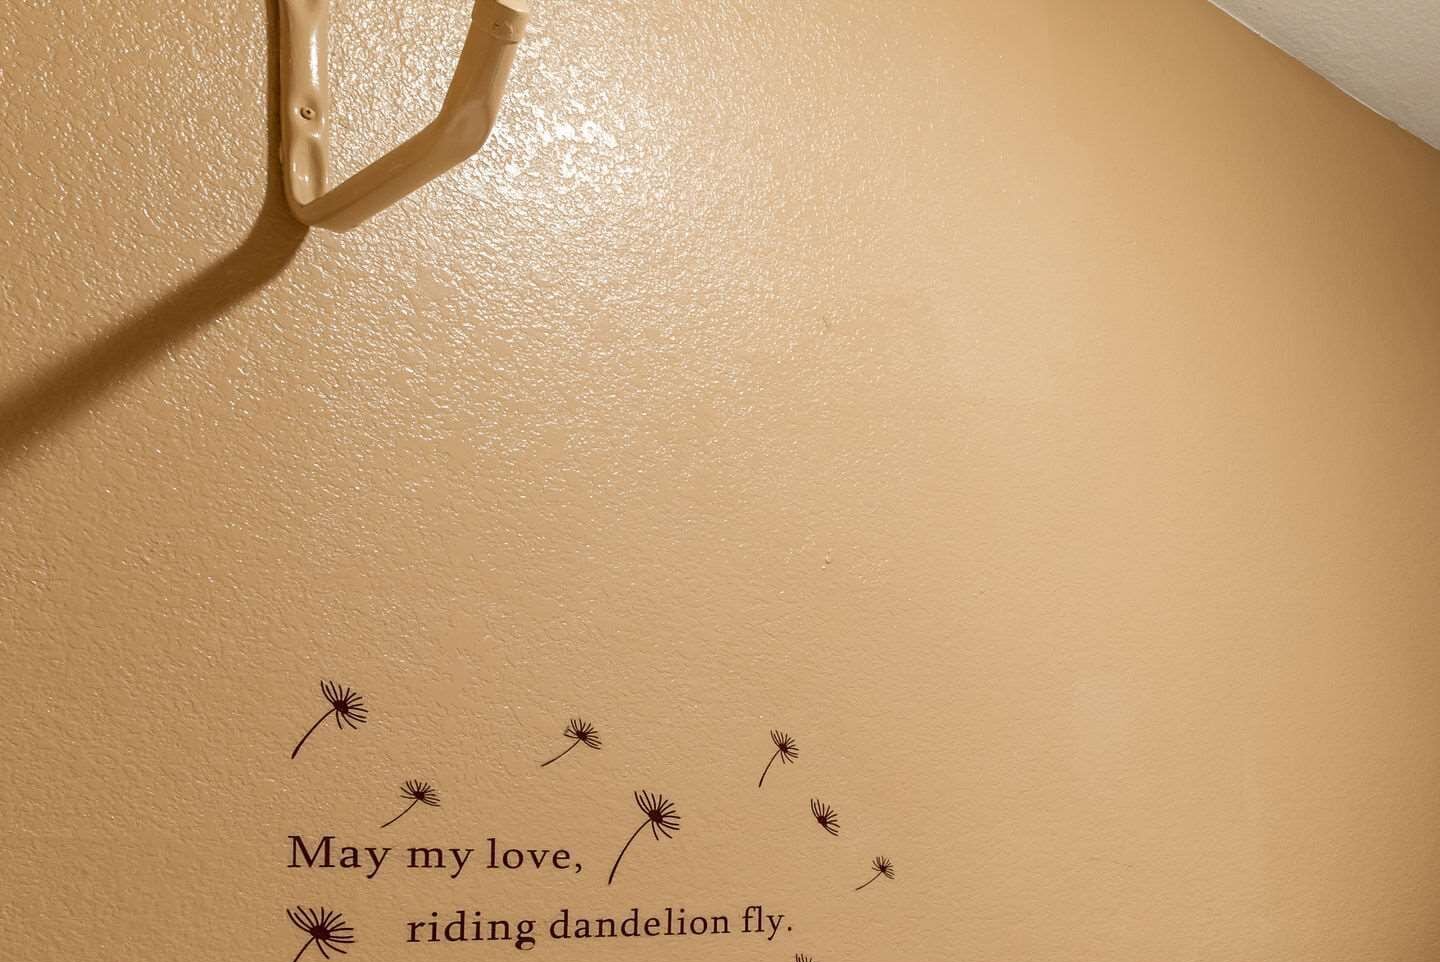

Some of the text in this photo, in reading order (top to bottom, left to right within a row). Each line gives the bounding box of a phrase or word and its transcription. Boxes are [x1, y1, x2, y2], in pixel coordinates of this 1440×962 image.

[287, 835, 582, 879] May my love,
[406, 905, 793, 951] riding dandelion fly.
